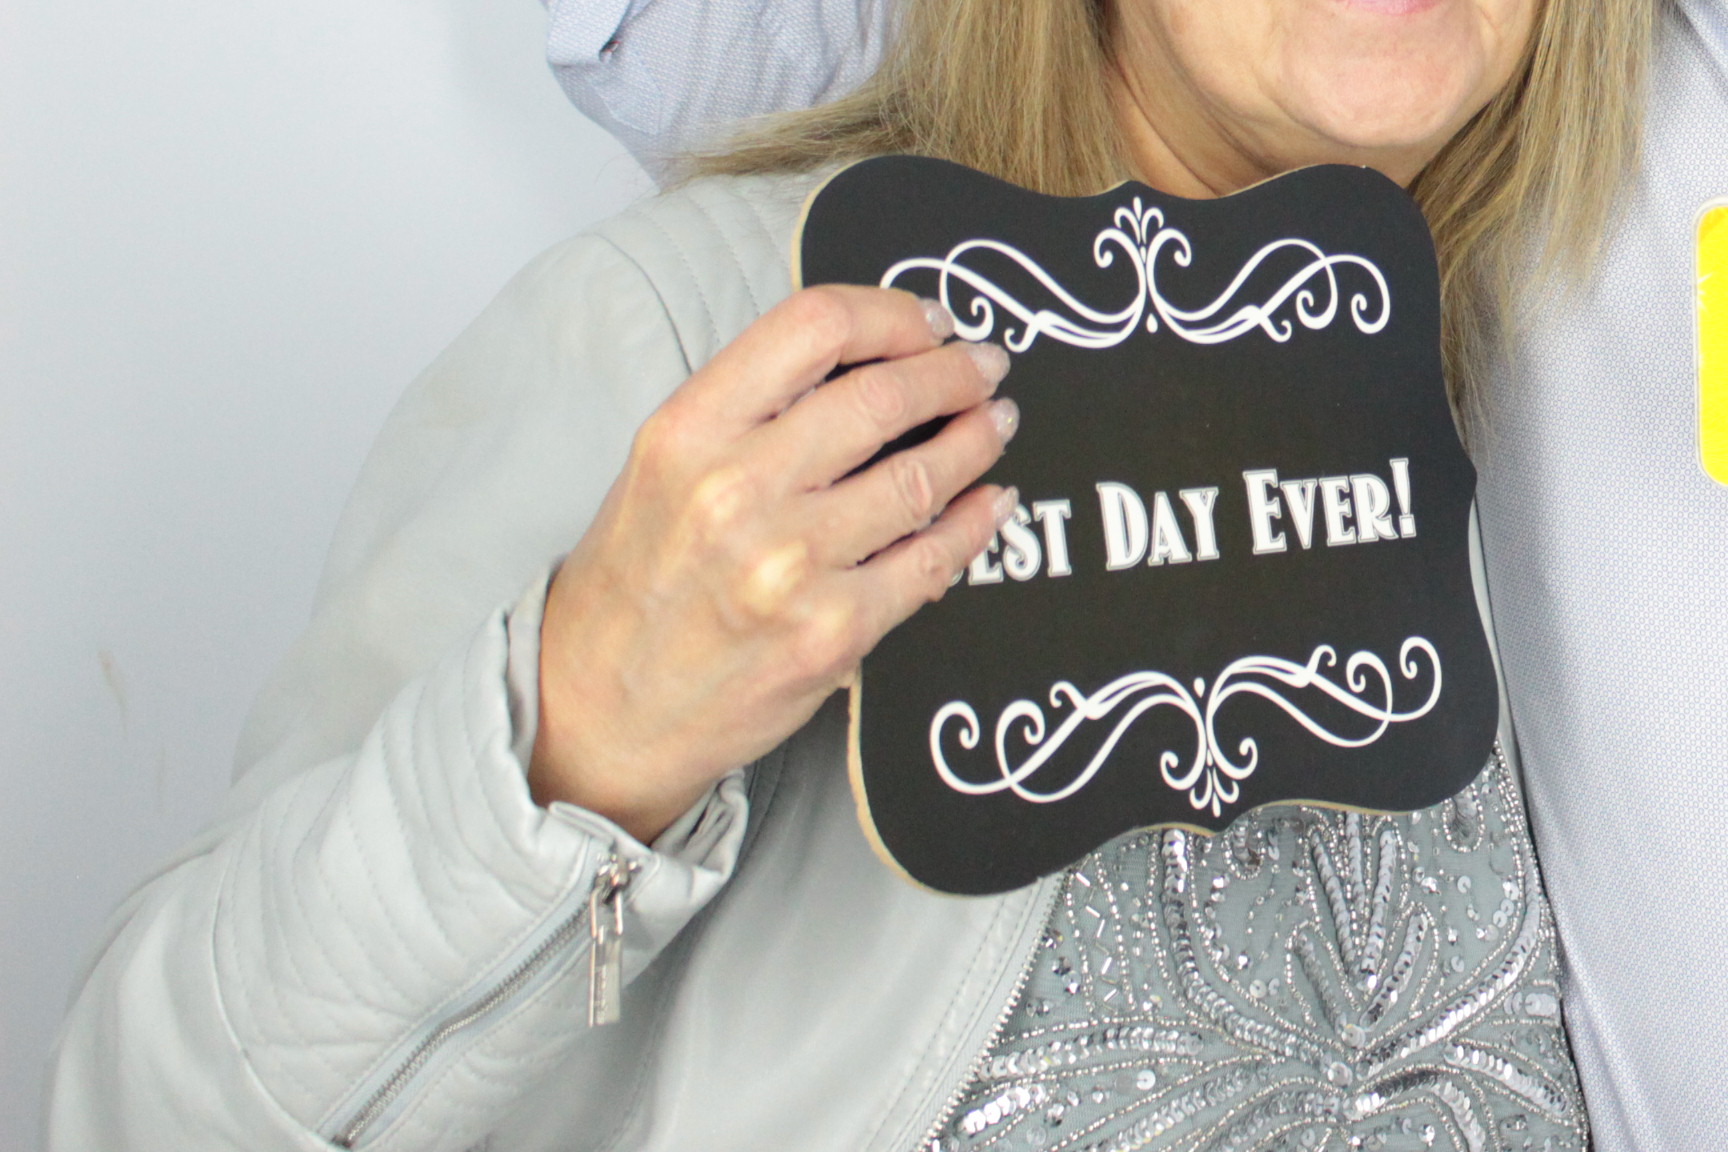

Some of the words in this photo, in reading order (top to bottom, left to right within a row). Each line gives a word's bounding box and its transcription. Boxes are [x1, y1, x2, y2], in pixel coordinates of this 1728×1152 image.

[947, 498, 1073, 587] EST
[1095, 481, 1220, 572] DAY
[1242, 456, 1417, 556] EVER!
